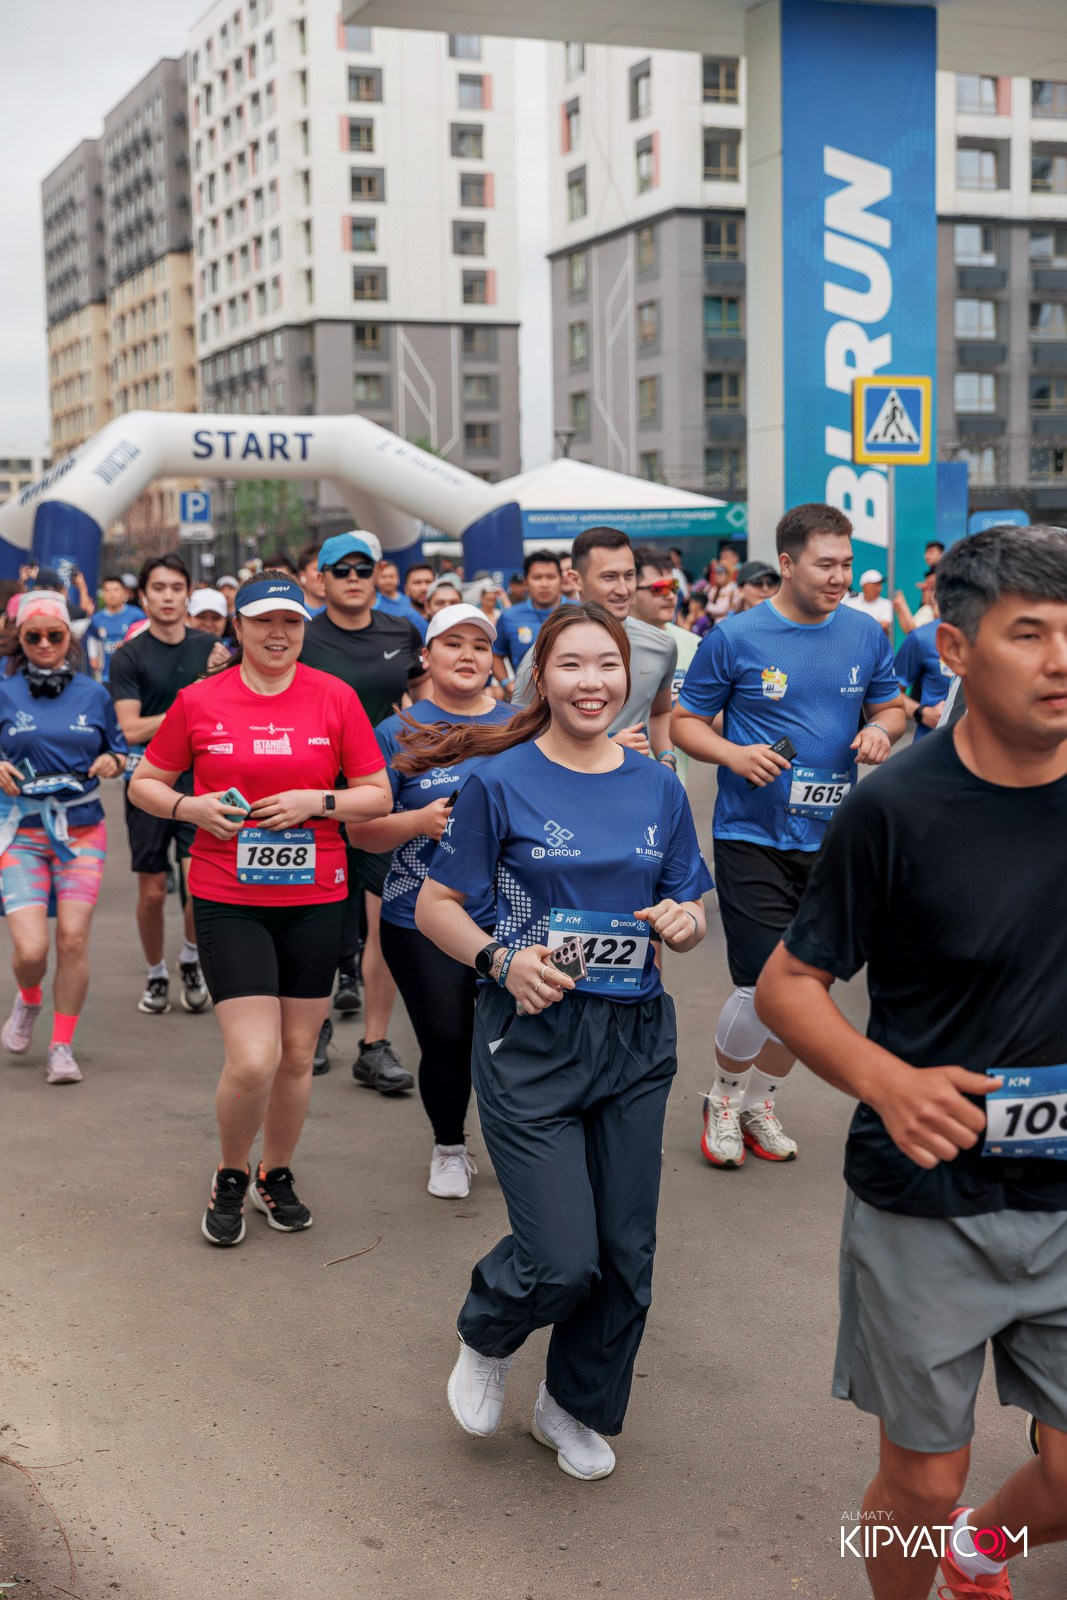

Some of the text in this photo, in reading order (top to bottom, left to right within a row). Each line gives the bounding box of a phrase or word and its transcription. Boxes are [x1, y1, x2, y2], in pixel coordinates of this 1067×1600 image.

[823, 145, 893, 396] RUN
[193, 431, 313, 460] START
[186, 493, 207, 522] P
[307, 737, 331, 746] HOKA
[432, 775, 460, 785] GROUP
[802, 785, 844, 803] 1615
[241, 830, 249, 838] 5
[247, 847, 308, 866] 1868
[533, 848, 581, 858] BI GROUP
[555, 913, 581, 924] 5 KM
[563, 936, 637, 965] 422
[1008, 1077, 1031, 1087] KM
